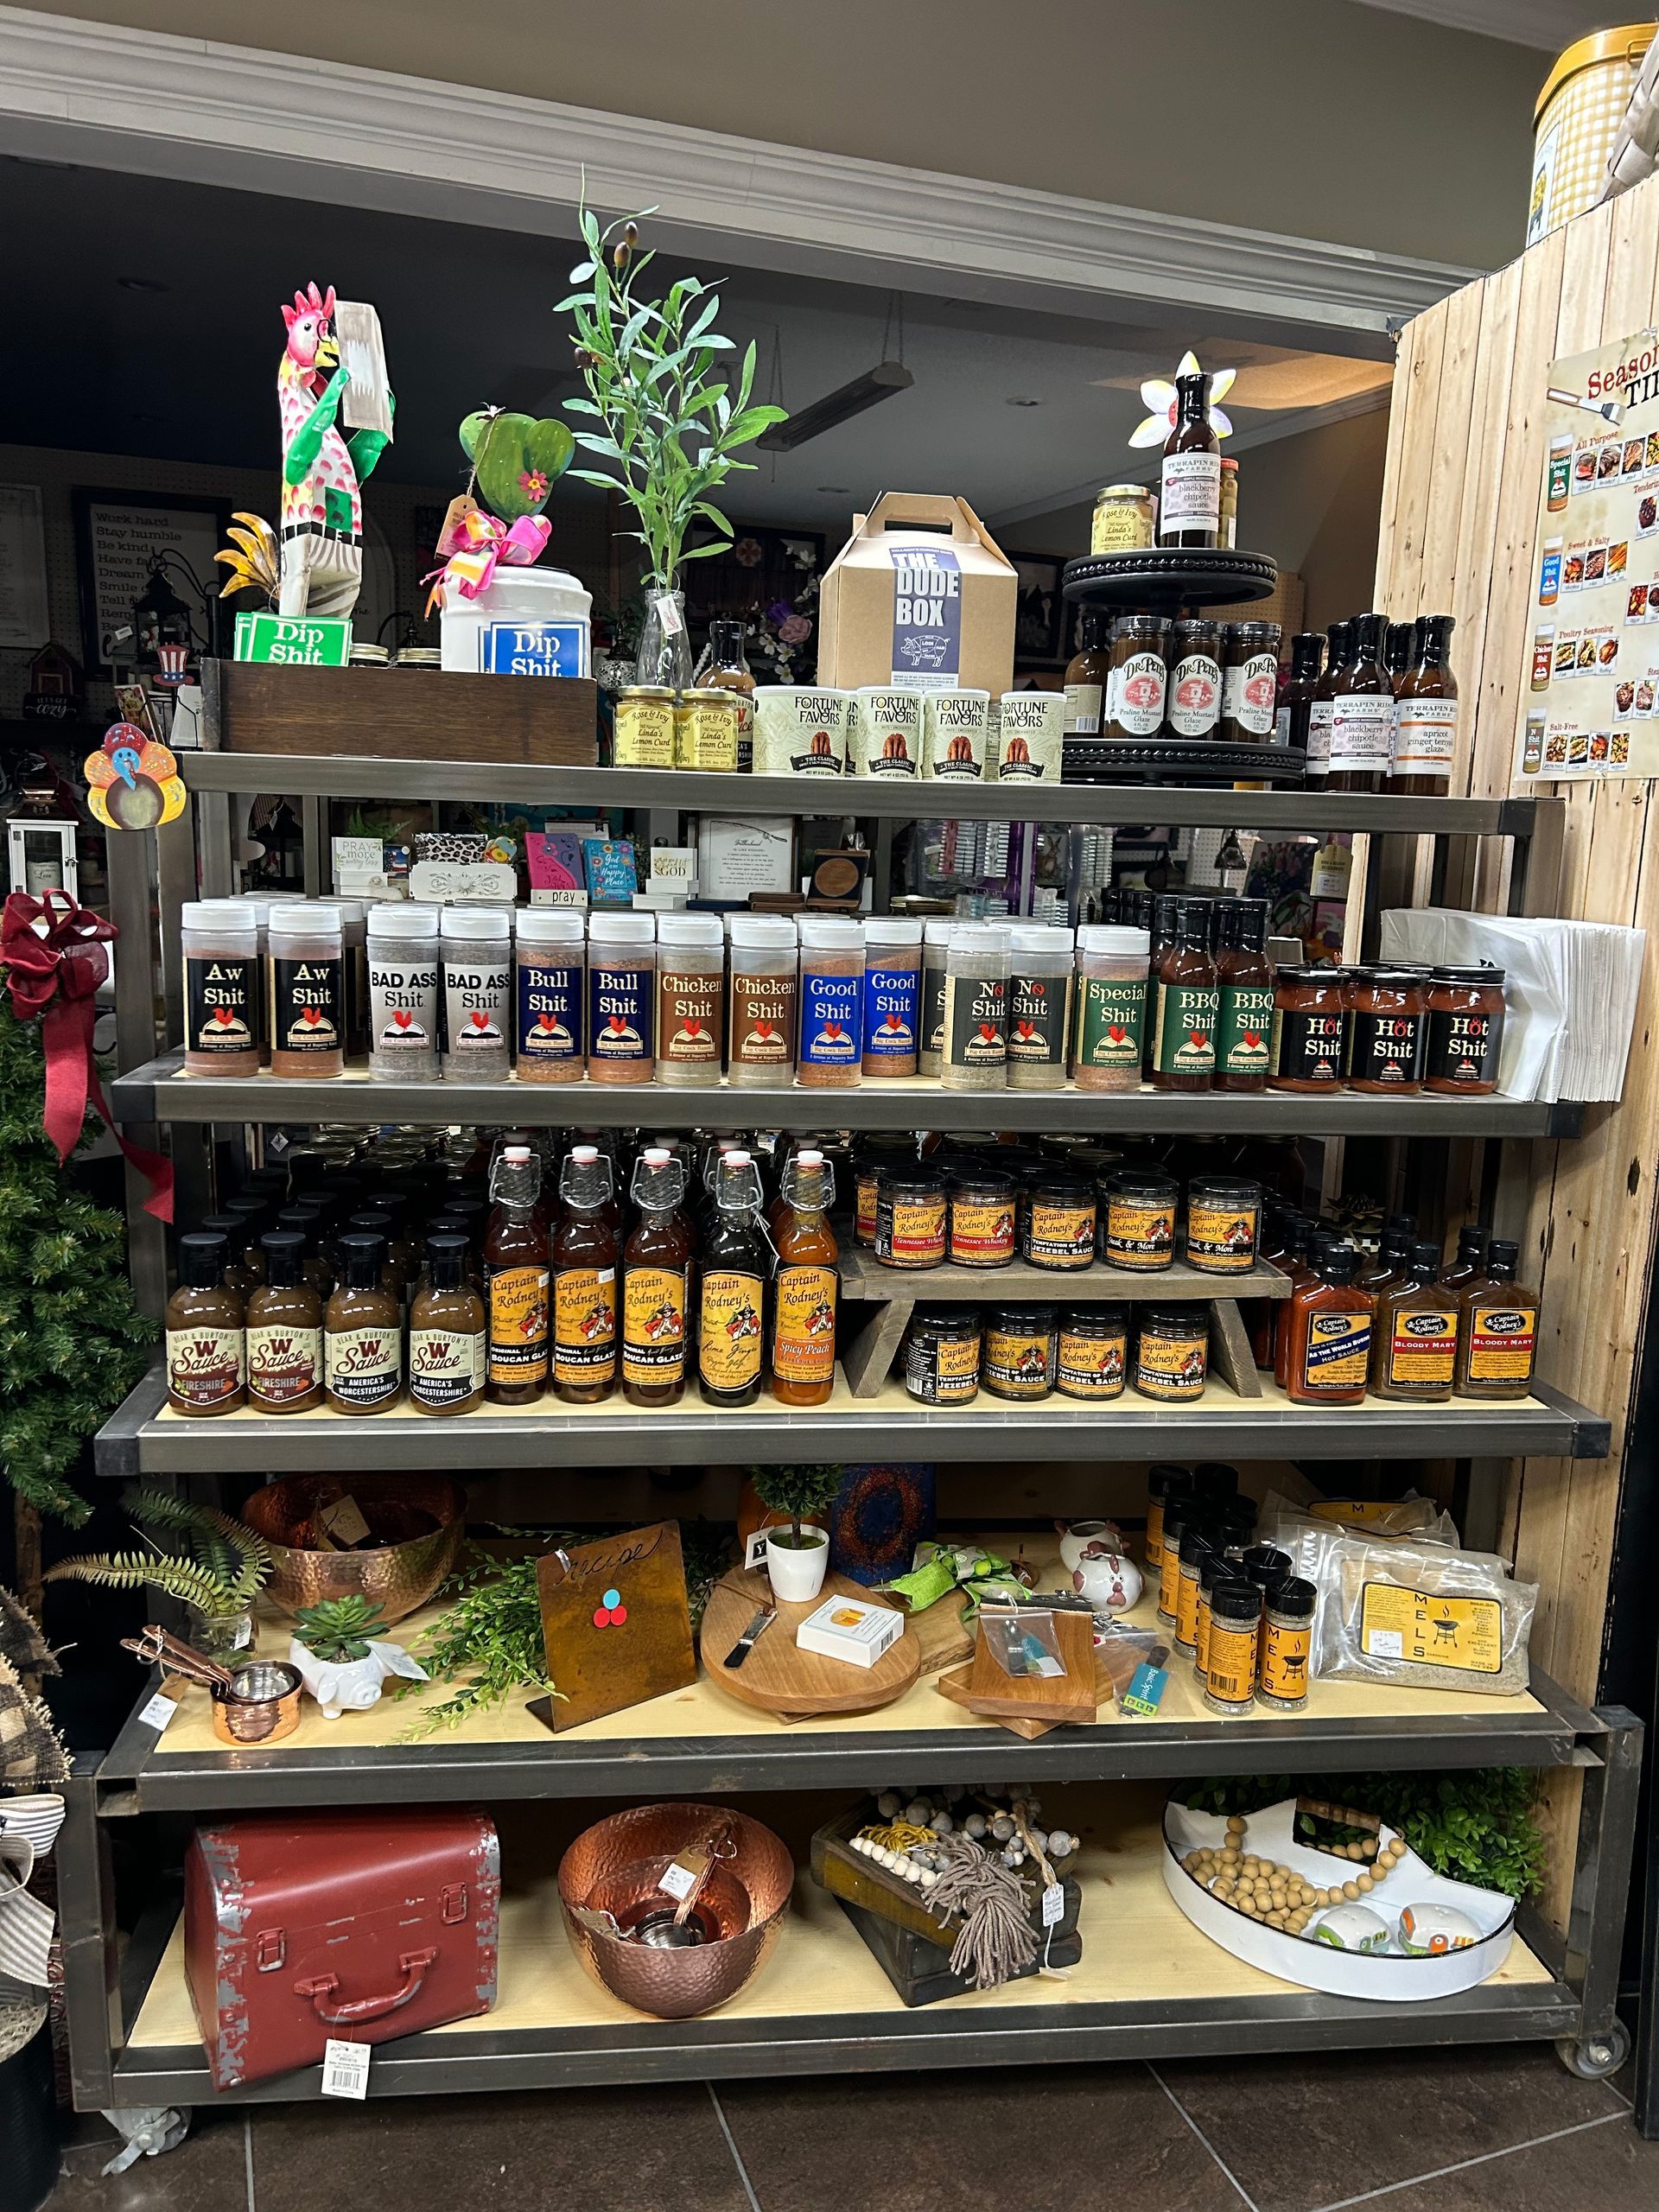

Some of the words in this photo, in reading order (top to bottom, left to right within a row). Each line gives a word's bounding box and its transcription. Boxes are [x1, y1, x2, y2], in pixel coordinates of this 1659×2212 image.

[1575, 440, 1587, 451] All
[1590, 431, 1618, 448] Purpose
[96, 512, 131, 524] Work
[136, 517, 169, 527] hard
[96, 526, 128, 537] Stay
[130, 529, 182, 541] humble
[97, 540, 115, 550] Be
[118, 542, 150, 553] kind
[1567, 540, 1586, 550] Sweet
[1594, 537, 1611, 549] Salty
[98, 554, 133, 565] Have
[893, 552, 939, 569] THE
[99, 568, 146, 580] Dream
[99, 582, 138, 593] Smile
[897, 569, 960, 598] DUDE
[896, 598, 944, 627] BOX
[273, 621, 325, 647] Dip
[1559, 627, 1582, 640] Poultry
[1584, 624, 1615, 638] Seasoning
[513, 630, 562, 660] Dip
[268, 645, 324, 666] Shit
[511, 656, 563, 678] Shit
[795, 696, 842, 712] FORTUNE
[871, 696, 919, 711] FORTUNE
[937, 699, 985, 714] FORTUNE
[656, 711, 670, 724] Ivy
[799, 709, 841, 726] FAVORS
[875, 710, 916, 724] FAVORS
[940, 713, 983, 727] FAVORS
[638, 729, 664, 738] Linda's
[1344, 725, 1383, 734] blackberry
[1549, 722, 1579, 732] Salt-Free
[654, 738, 671, 747] Curd
[1348, 734, 1379, 742] chipotle
[1425, 745, 1445, 753] glaze
[342, 841, 373, 851] PRAY
[601, 868, 625, 878] Happy
[660, 867, 686, 876] GOD
[552, 890, 575, 906] pray
[206, 964, 243, 981] Aw
[293, 963, 328, 981] Aw
[372, 972, 405, 988] BAD
[408, 972, 437, 988] ASS
[528, 969, 569, 988] Bull
[447, 974, 482, 990] BAD
[485, 975, 511, 989] ASS
[598, 973, 639, 991] Bull
[662, 975, 722, 994] Chicken
[735, 976, 795, 995] Chicken
[810, 979, 857, 996] Good
[872, 973, 916, 990] Good
[204, 988, 245, 1005] Shit
[292, 988, 332, 1005] Shit
[385, 992, 424, 1007] Shit
[461, 993, 499, 1009] Shit
[1090, 982, 1147, 1004] Special
[528, 995, 568, 1013] Shit
[599, 997, 639, 1014] Shit
[675, 1000, 713, 1018] Shit
[875, 995, 912, 1013] Shit
[971, 999, 1006, 1016] Shit
[1012, 998, 1047, 1015] Shit
[1179, 993, 1219, 1011] BBQ
[1234, 993, 1274, 1012] BBQ
[747, 1002, 785, 1020] Shit
[814, 1002, 852, 1020] Shit
[1100, 1007, 1136, 1023] Shit
[1182, 1013, 1216, 1029] Shit
[1236, 1014, 1270, 1029] Shit
[1306, 1015, 1342, 1035] Hot
[1375, 1016, 1414, 1037] Hot
[1450, 1016, 1489, 1036] Hot
[1305, 1039, 1341, 1056] Shit
[1373, 1040, 1413, 1058] Shit
[1447, 1039, 1487, 1056] Shit
[896, 1210, 928, 1224] Captain
[899, 1217, 935, 1233] Rodney's
[1034, 1211, 1065, 1224] Captain
[1109, 1211, 1138, 1224] Captain
[1037, 1222, 1073, 1236] Rodney's
[1111, 1221, 1146, 1235] Rodney's
[983, 1236, 1007, 1246] Whiskey
[1033, 1239, 1066, 1248] TEMPTATION
[1136, 1242, 1156, 1250] More
[1032, 1245, 1070, 1255] JEZEBEL
[1071, 1246, 1093, 1255] SAUCE
[626, 1276, 664, 1295] Captain
[703, 1278, 741, 1294] Captain
[780, 1273, 820, 1291] Captain
[627, 1287, 673, 1307] Rodney's
[705, 1293, 750, 1311] Rodney's
[785, 1287, 829, 1306] Rodney's
[1322, 1319, 1346, 1330] Captain
[1492, 1320, 1522, 1332] Rodney's
[1493, 1314, 1520, 1325] Captain
[1322, 1324, 1348, 1333] Rodney's
[200, 1332, 236, 1342] BURTON'S
[1395, 1340, 1430, 1349] BLOODY
[1473, 1338, 1509, 1346] BLOODY
[194, 1339, 219, 1358] W
[556, 1346, 582, 1356] ORIGINAL
[779, 1341, 803, 1357] Spicy
[804, 1344, 830, 1356] Peach
[1318, 1348, 1332, 1357] THE
[1332, 1342, 1352, 1354] WORLD
[1338, 1346, 1361, 1359] SAUCE
[173, 1345, 230, 1375] Sauce
[335, 1346, 391, 1375] Sauce
[556, 1351, 591, 1364] BOUCAN
[593, 1350, 616, 1363] GLAZE
[181, 1378, 226, 1391] FIRESHIRE
[348, 1376, 385, 1386] AMERICA'S
[1139, 1373, 1176, 1387] JEZEBEL
[1178, 1377, 1204, 1387] SAUCE
[338, 1383, 394, 1395] WORCESTERSHIRE
[554, 1528, 664, 1587] recipe
[1146, 1668, 1160, 1683] Basic
